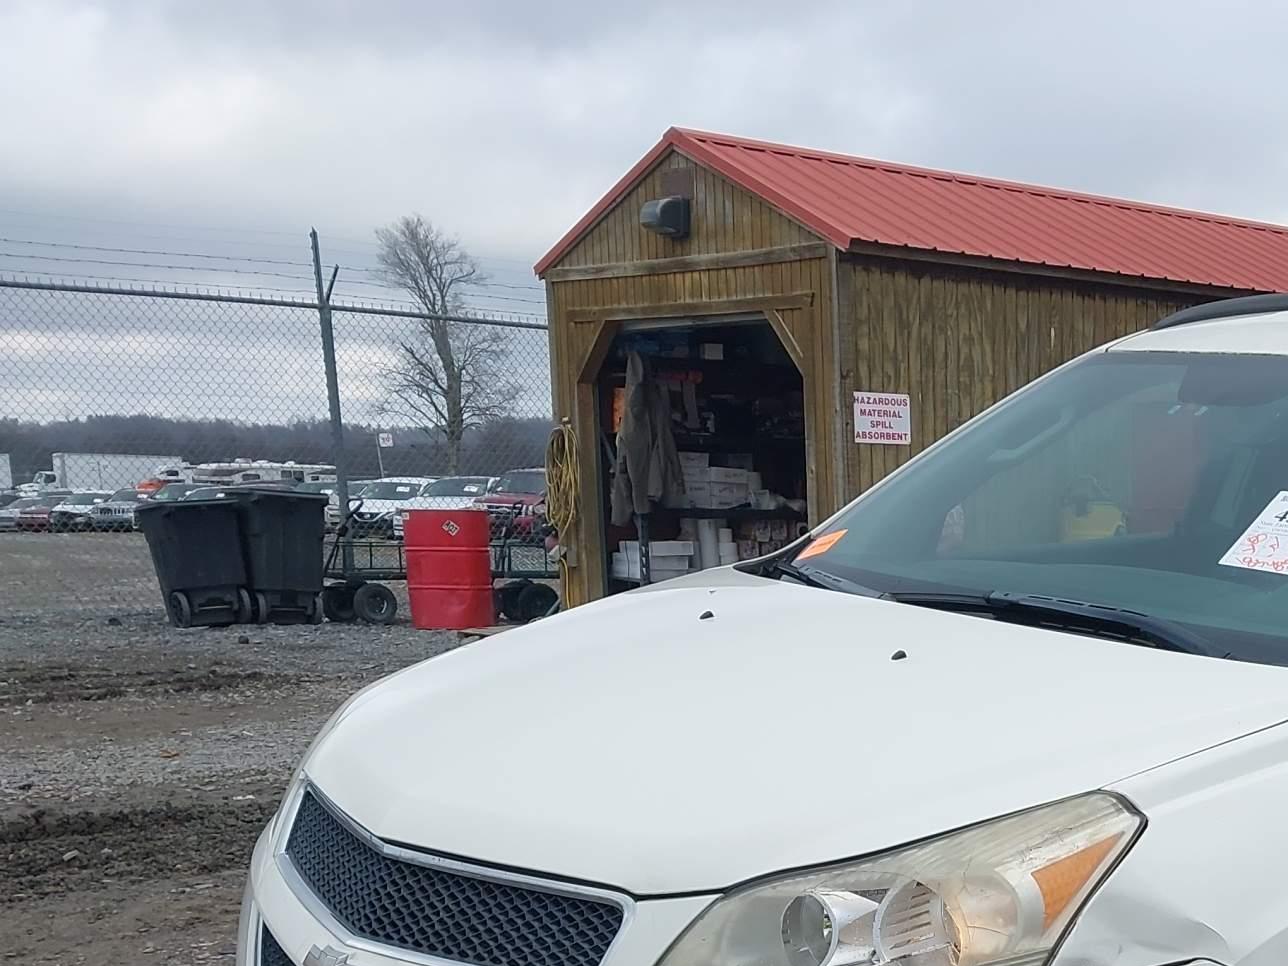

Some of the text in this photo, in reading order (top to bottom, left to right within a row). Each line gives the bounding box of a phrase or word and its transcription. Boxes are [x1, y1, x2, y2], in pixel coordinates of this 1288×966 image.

[854, 396, 908, 407] HAZARDOUS
[860, 408, 903, 419] MATERIAL
[870, 420, 894, 430] SPILL
[856, 431, 909, 441] ABSORBENT
